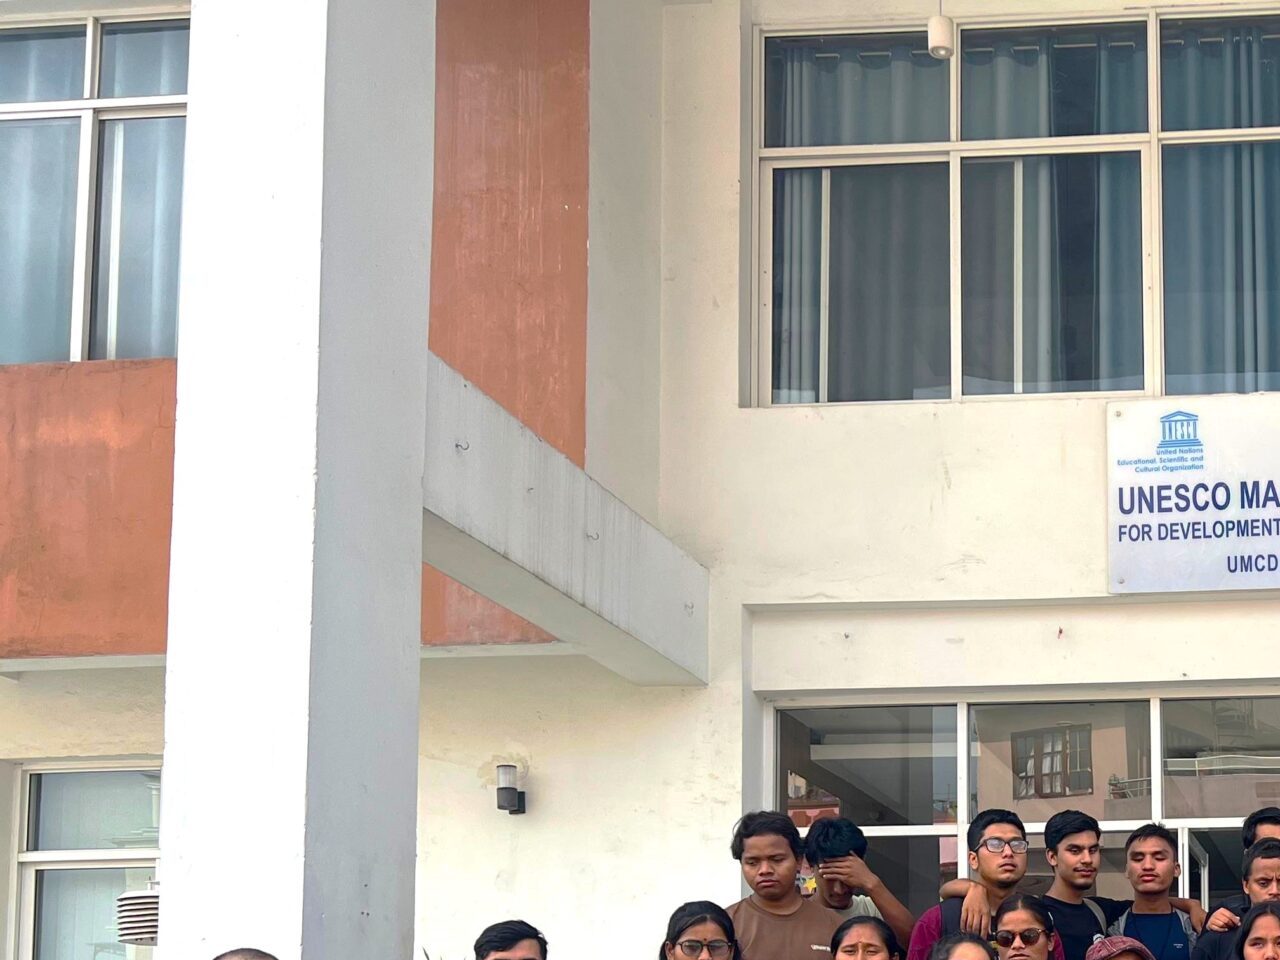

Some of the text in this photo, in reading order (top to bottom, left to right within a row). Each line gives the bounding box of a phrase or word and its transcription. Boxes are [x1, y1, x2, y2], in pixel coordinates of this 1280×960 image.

[1162, 421, 1197, 440] UNESCO
[1161, 464, 1204, 472] Organization
[1117, 482, 1231, 515] UNESCO
[1118, 524, 1153, 542] FOR
